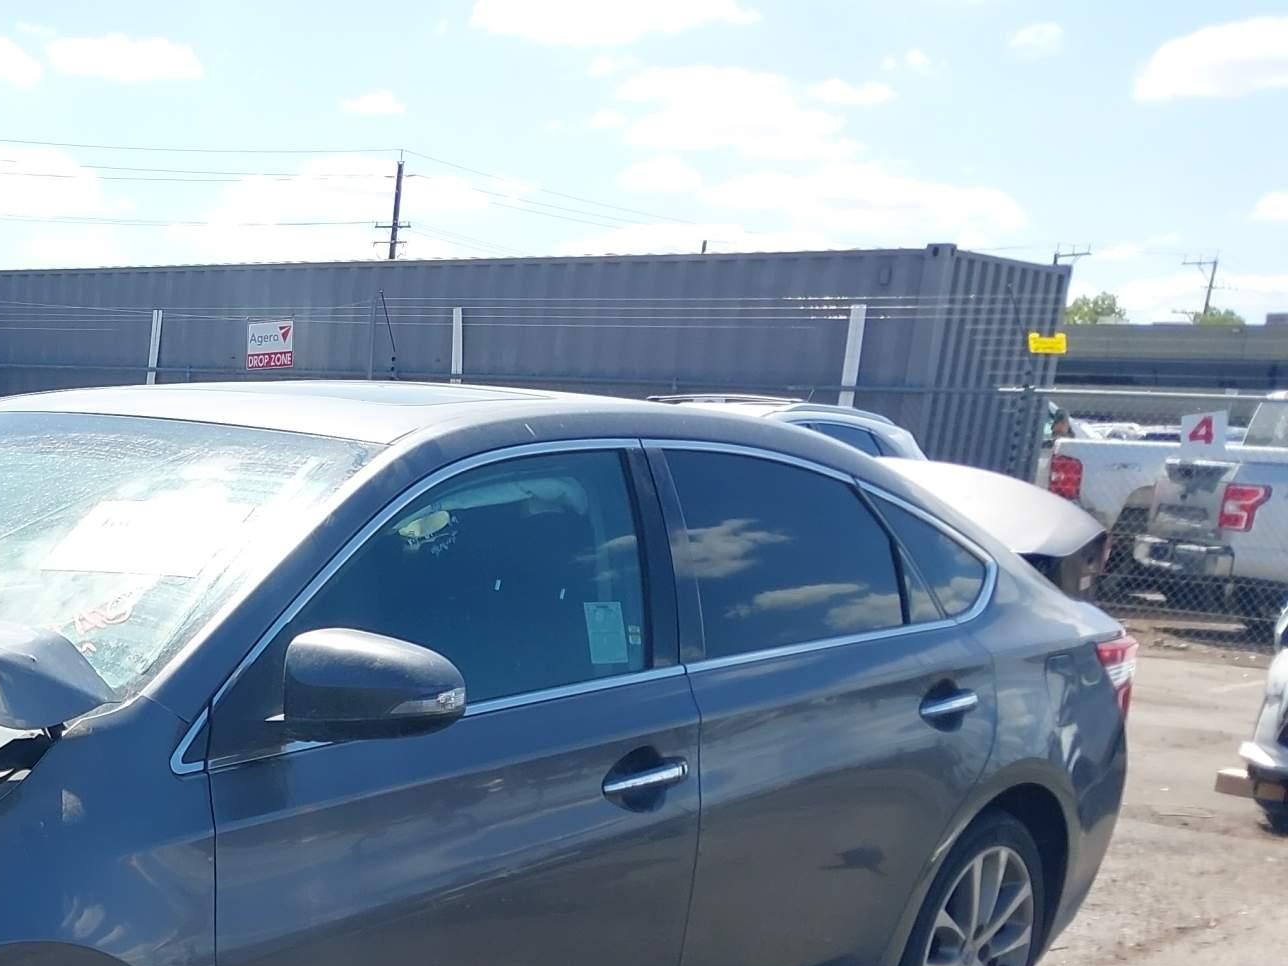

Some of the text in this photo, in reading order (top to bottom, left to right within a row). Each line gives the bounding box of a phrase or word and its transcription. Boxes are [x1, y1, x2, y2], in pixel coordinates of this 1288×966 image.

[249, 333, 279, 346] Agero
[248, 353, 291, 367] DROP ZONE
[1189, 415, 1214, 445] 4
